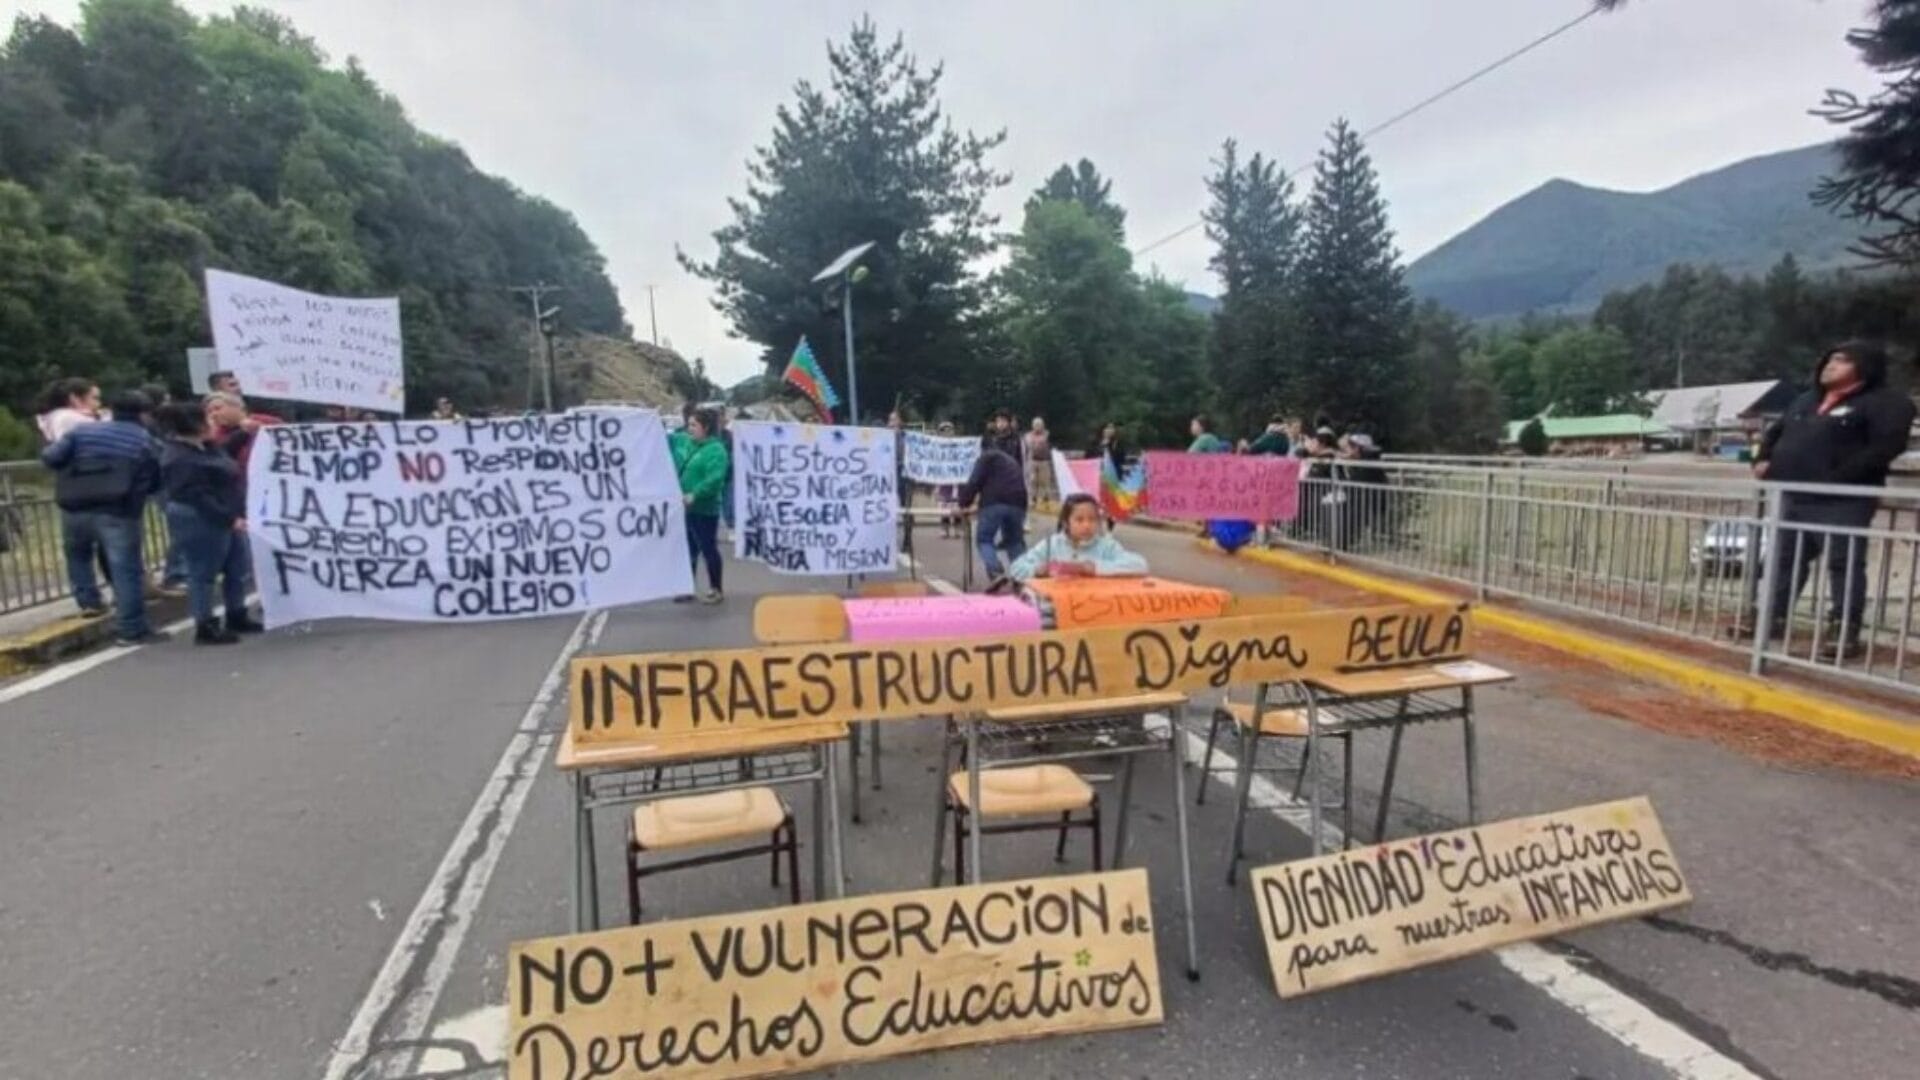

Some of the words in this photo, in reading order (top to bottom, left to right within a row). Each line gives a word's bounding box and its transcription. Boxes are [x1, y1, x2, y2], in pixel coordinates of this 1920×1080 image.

[392, 418, 438, 446] LO
[270, 450, 311, 477] EL
[312, 450, 382, 483] MOP
[397, 452, 446, 483] NO
[528, 480, 571, 514] ES
[582, 467, 629, 501] UN
[863, 499, 890, 524] ES
[273, 550, 436, 595] FUERZA
[448, 553, 494, 583] UN
[505, 543, 612, 577] NUEVO
[580, 638, 1099, 731] INFRAESTRUCTURA
[1125, 625, 1308, 690] Digna
[1430, 824, 1642, 893] Educativa
[1288, 933, 1378, 988] para
[1396, 900, 1512, 948] nuestras
[1518, 849, 1683, 924] INFANCIAS
[519, 947, 613, 1017] NO
[1121, 903, 1149, 934] de
[842, 951, 1150, 1046] Educativos
